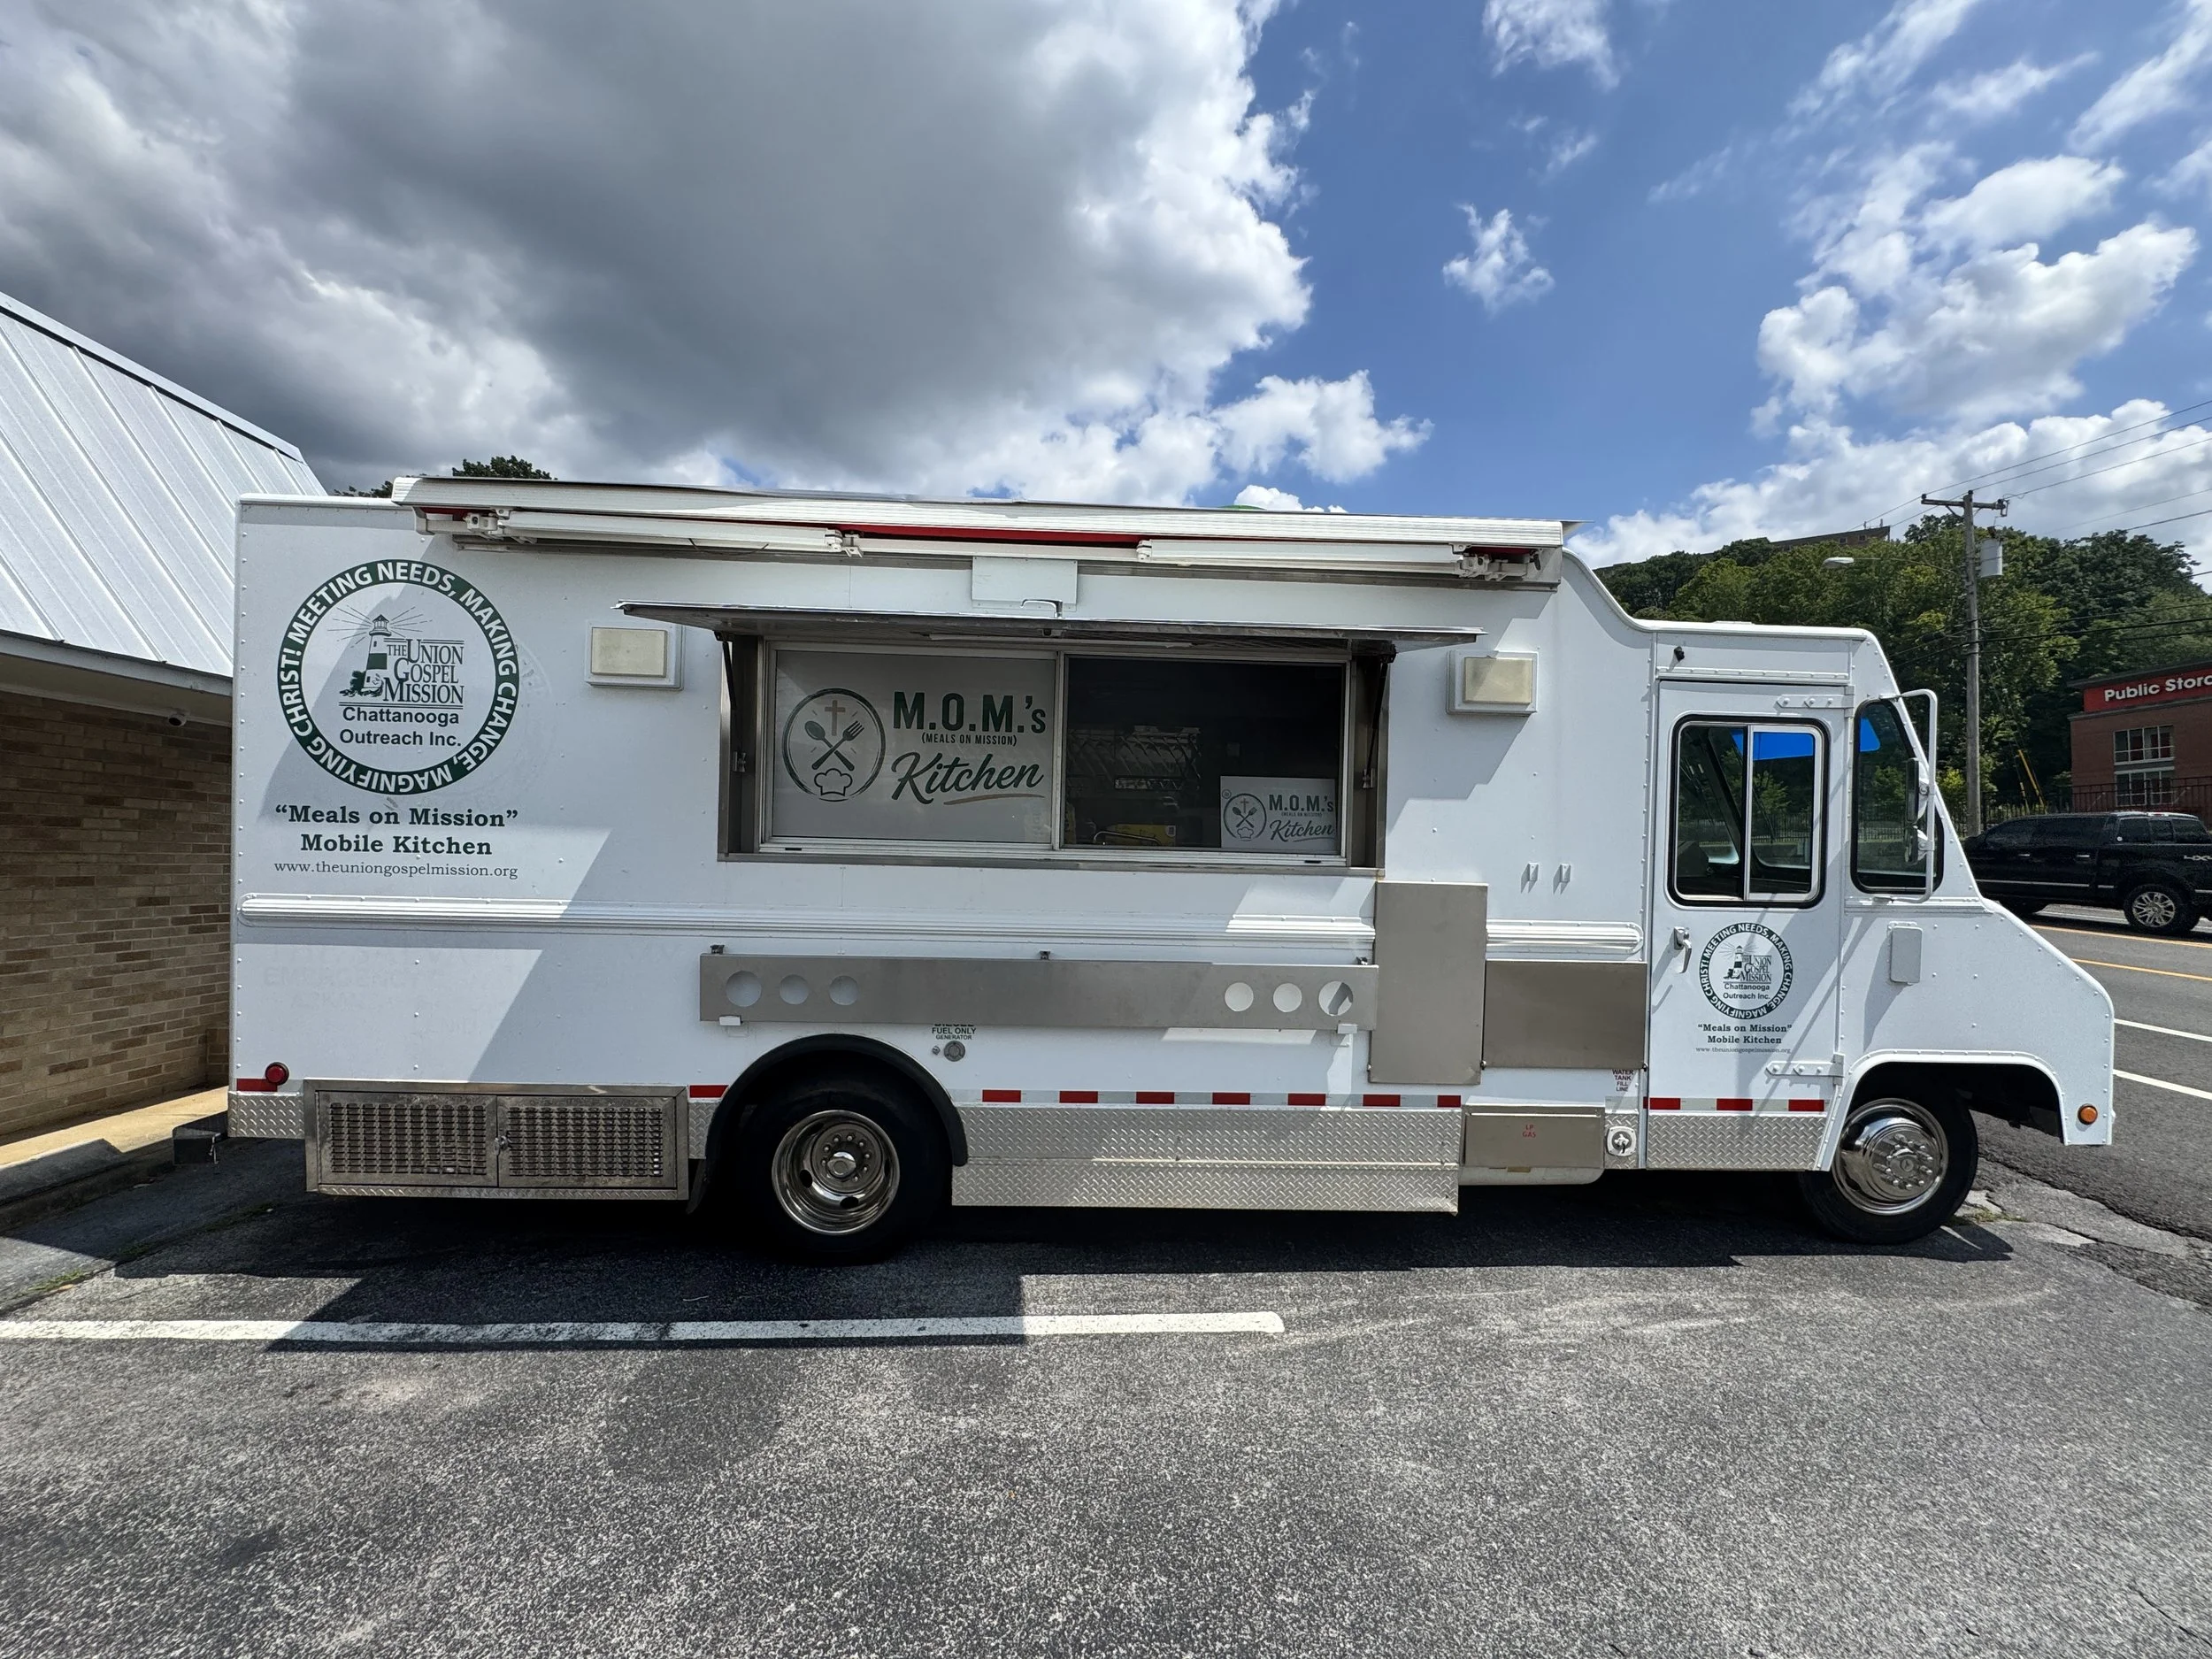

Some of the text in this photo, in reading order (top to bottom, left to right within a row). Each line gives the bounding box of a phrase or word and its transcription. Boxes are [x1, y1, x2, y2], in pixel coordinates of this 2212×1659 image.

[387, 639, 465, 664] THE UNION
[280, 561, 517, 793] MEETING NEEDS, MAKING CHANGE, MAGNIFYING CHRIST!
[394, 657, 459, 684] GOSPEL
[383, 677, 465, 704] MISSION
[2104, 683, 2161, 702] Public
[342, 706, 459, 727] Chattanooga
[339, 728, 462, 747] Outreach Inc.
[921, 732, 1018, 747] (MEALS ON MISSION)
[891, 752, 1045, 804] Kitchen
[369, 811, 401, 825] on
[1269, 819, 1334, 842] Kitchen
[300, 833, 493, 856] Mobile Kitchen
[273, 861, 518, 879] www.theuniongospelmission.org
[1738, 923, 1770, 938] NEEDS,
[1703, 926, 1737, 958] MEETING
[1770, 933, 1792, 970] MAKING
[1744, 963, 1770, 974] GOSPEL
[1748, 955, 1771, 965] UNION
[1740, 971, 1771, 982] MISSION
[1724, 983, 1770, 992] Chattanooga
[1766, 972, 1792, 1010] CHANGE,
[1710, 995, 1768, 1018] MAGNIFYING
[1708, 1035, 1782, 1044] Mobile Kitchen
